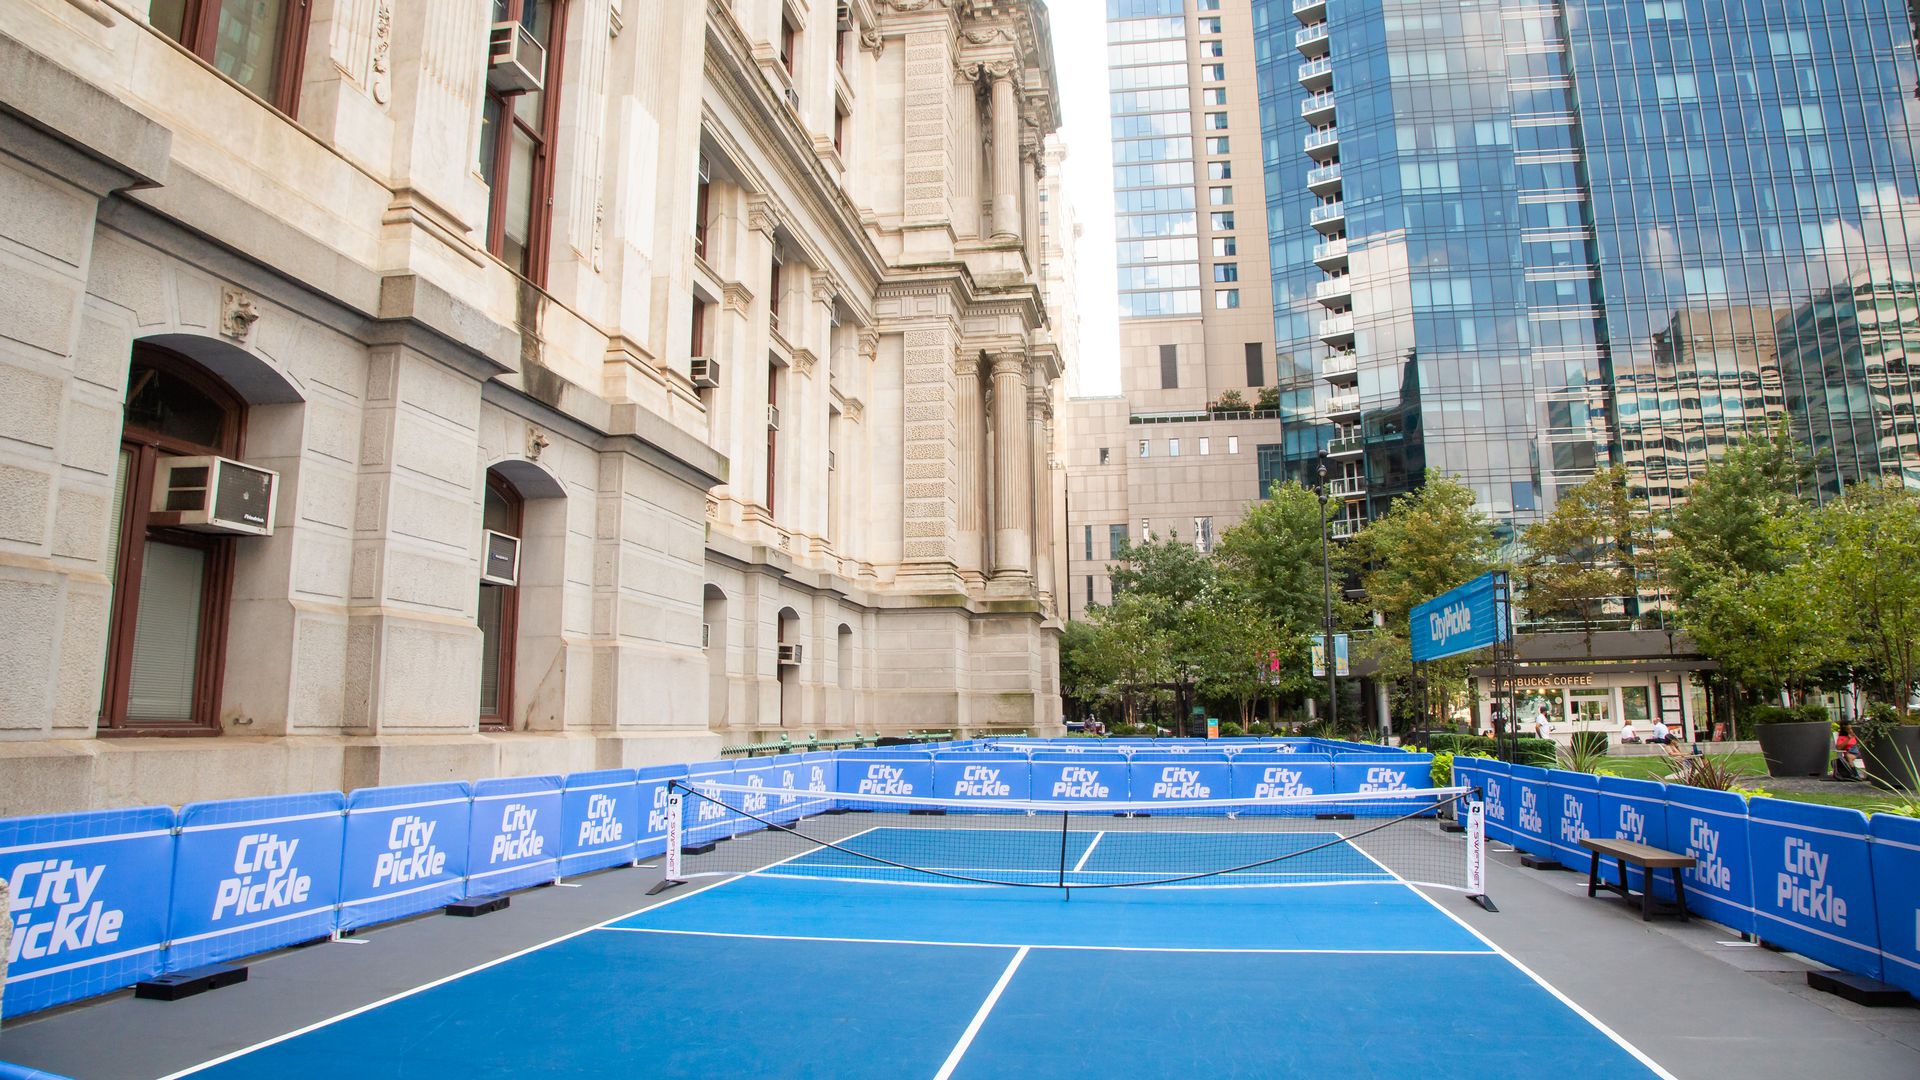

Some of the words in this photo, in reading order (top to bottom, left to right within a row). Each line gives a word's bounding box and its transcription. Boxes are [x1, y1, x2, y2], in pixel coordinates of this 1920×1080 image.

[1429, 600, 1471, 647] CityPickle
[1491, 677, 1550, 688] SARBUCKS
[1553, 676, 1592, 686] COFFEE
[858, 779, 913, 795] Pickle
[867, 764, 903, 784] City
[963, 765, 1000, 785] City
[1061, 766, 1099, 785] City
[1161, 767, 1200, 786] City
[1263, 768, 1302, 786] City
[1367, 768, 1406, 786] City
[653, 786, 668, 809] Cit
[955, 781, 1010, 796] Pickle
[1052, 782, 1109, 798] Pickle
[1152, 783, 1210, 799] Pickle
[1255, 783, 1313, 799] Pickle
[1487, 778, 1500, 800] City
[1522, 786, 1536, 812] City
[587, 794, 616, 821] City
[743, 793, 767, 812] Pickle
[1485, 796, 1505, 820] Pickle
[1564, 793, 1583, 825] City
[501, 804, 537, 838] City
[578, 817, 623, 847] Pickle
[1519, 807, 1542, 833] Pickle
[1620, 804, 1645, 839] City
[389, 816, 437, 852] City
[490, 830, 544, 864] Pickle
[1691, 817, 1719, 860] City
[234, 833, 299, 879] City
[372, 846, 446, 888] Pickle
[1784, 836, 1829, 889] City
[8, 859, 107, 913] City
[212, 868, 311, 921] Pickle
[1777, 872, 1847, 928] Pickle
[8, 901, 124, 963] ickle
